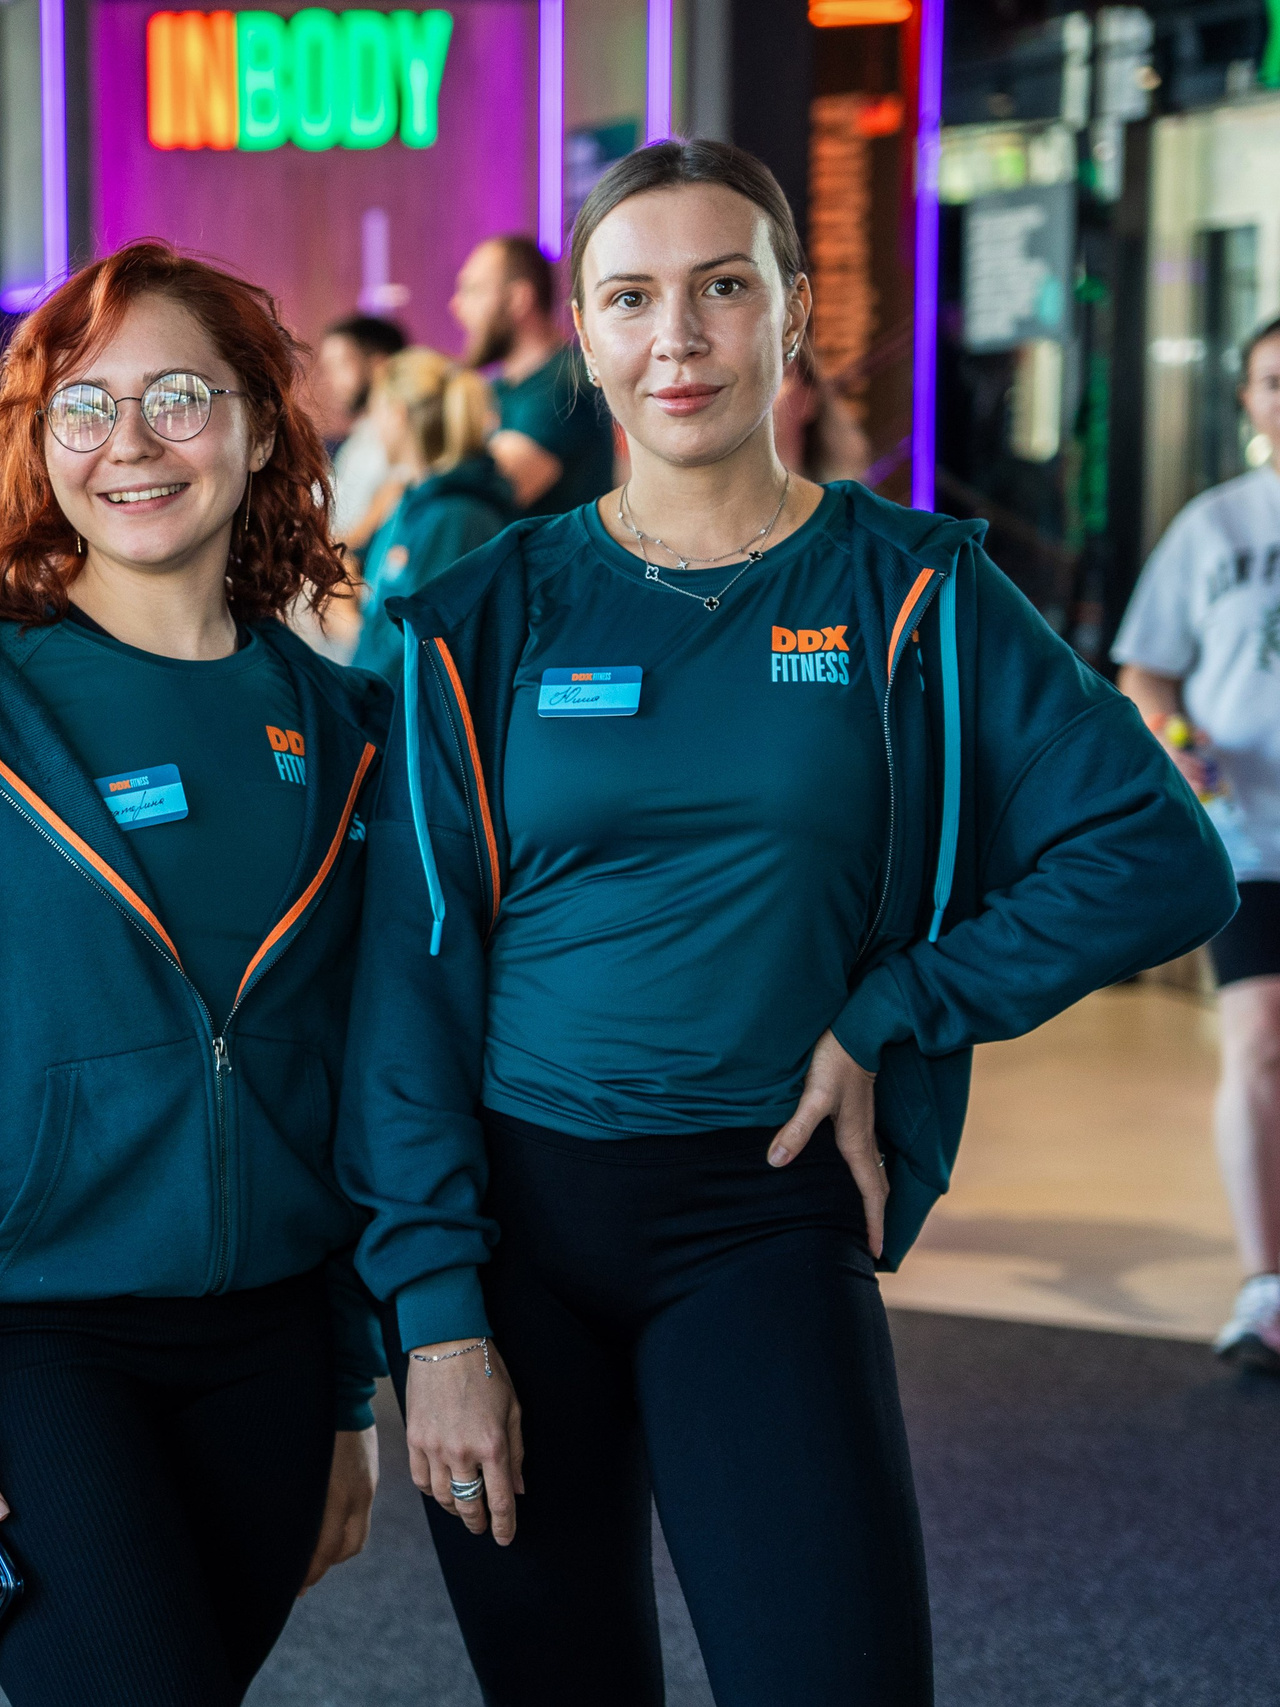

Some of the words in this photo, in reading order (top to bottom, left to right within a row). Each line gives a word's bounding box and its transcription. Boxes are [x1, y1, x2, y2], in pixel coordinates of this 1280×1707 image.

[146, 7, 453, 151] INBODY
[771, 625, 850, 653] DDX
[771, 652, 850, 686] FITNESS
[265, 724, 306, 757] DD
[273, 751, 307, 786] FITN
